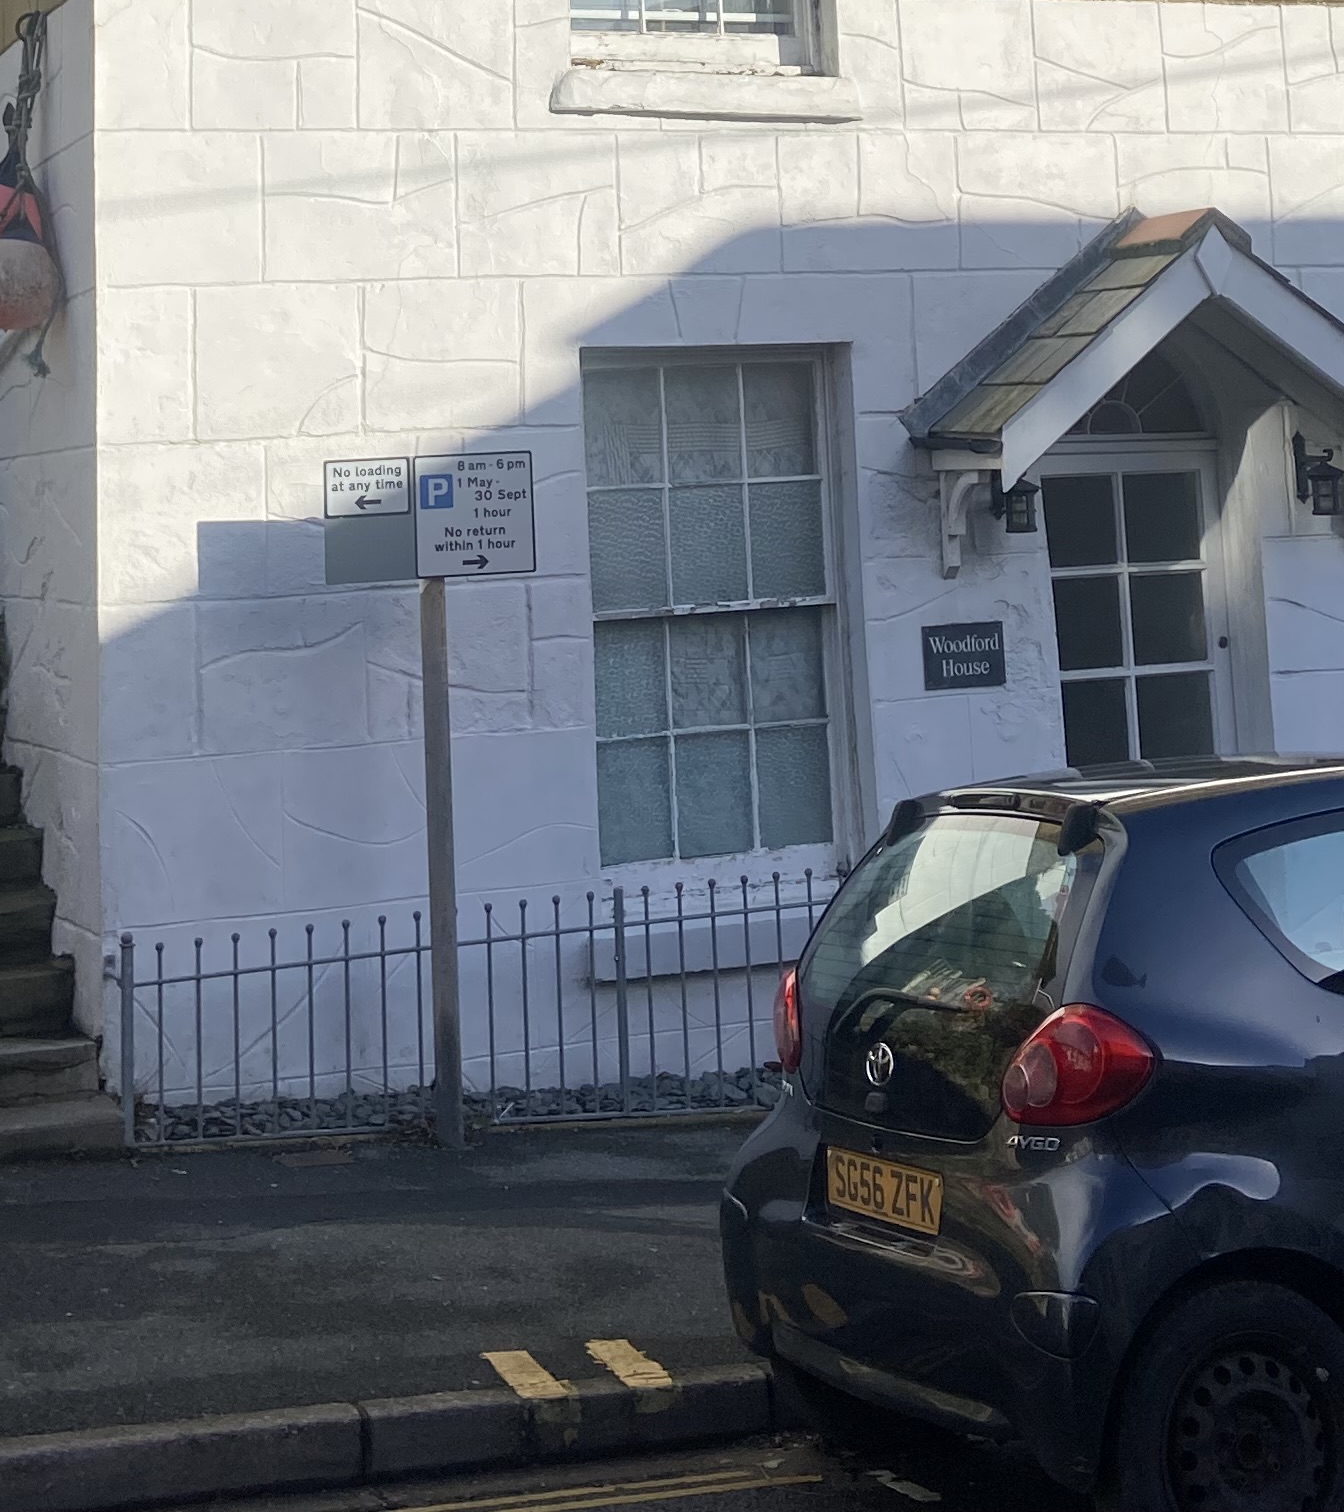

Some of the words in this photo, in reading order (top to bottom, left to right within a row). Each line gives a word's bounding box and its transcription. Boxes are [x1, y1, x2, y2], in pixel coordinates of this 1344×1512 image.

[333, 467, 351, 478] No
[356, 465, 402, 478] loading
[457, 460, 465, 471] 8
[468, 461, 487, 471] am
[496, 459, 504, 470] 6
[507, 459, 526, 471] pm
[331, 481, 344, 492] at
[348, 481, 371, 493] any
[375, 479, 403, 490] time
[457, 477, 462, 488] 1
[467, 477, 494, 489] May
[428, 478, 449, 506] P
[474, 489, 493, 501] 30
[497, 488, 527, 501] Sept
[474, 507, 479, 518] 1
[483, 507, 512, 518] hour
[444, 527, 462, 538] No
[466, 525, 506, 537] return
[434, 539, 474, 552] within
[478, 539, 483, 550] 1
[487, 538, 516, 549] hour
[928, 632, 1000, 654] Woodford
[942, 659, 990, 678] House
[1006, 1135, 1060, 1151] AYGO
[835, 1155, 885, 1210] SG56
[890, 1169, 935, 1225] ZFK
